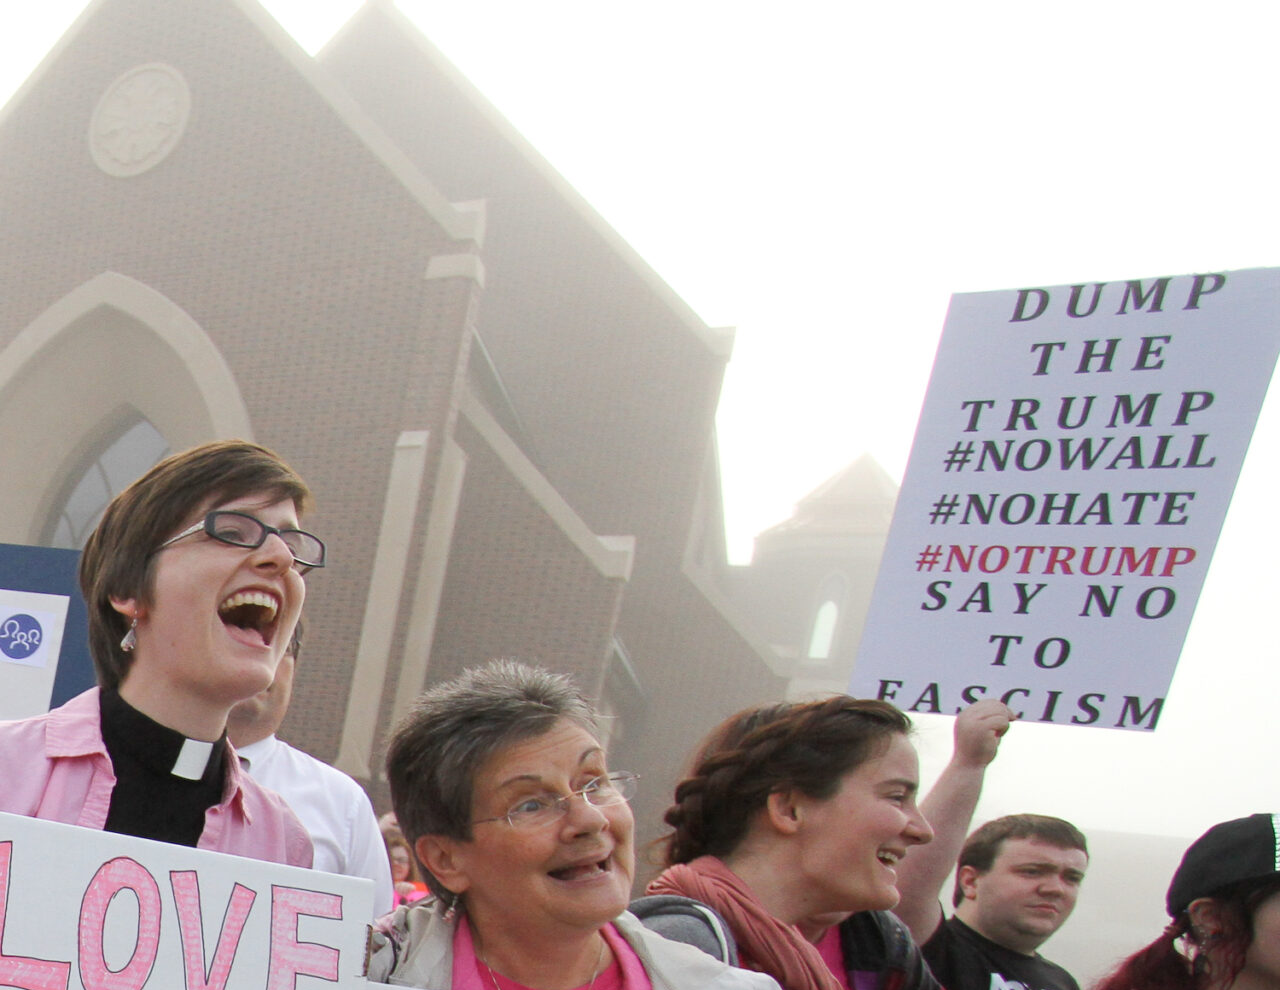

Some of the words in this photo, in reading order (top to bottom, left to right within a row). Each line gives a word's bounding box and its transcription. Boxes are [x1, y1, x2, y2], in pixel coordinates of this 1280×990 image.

[1009, 273, 1227, 323] DUMP
[1031, 335, 1172, 376] THE
[961, 391, 1215, 432] TRUMP
[943, 434, 1217, 473] #NOWALL
[929, 491, 1196, 526] #NOHATE
[915, 544, 1197, 577] #NOTRUMP
[921, 580, 1048, 615] SAY
[1078, 585, 1177, 620] NO
[989, 634, 1071, 669] TO
